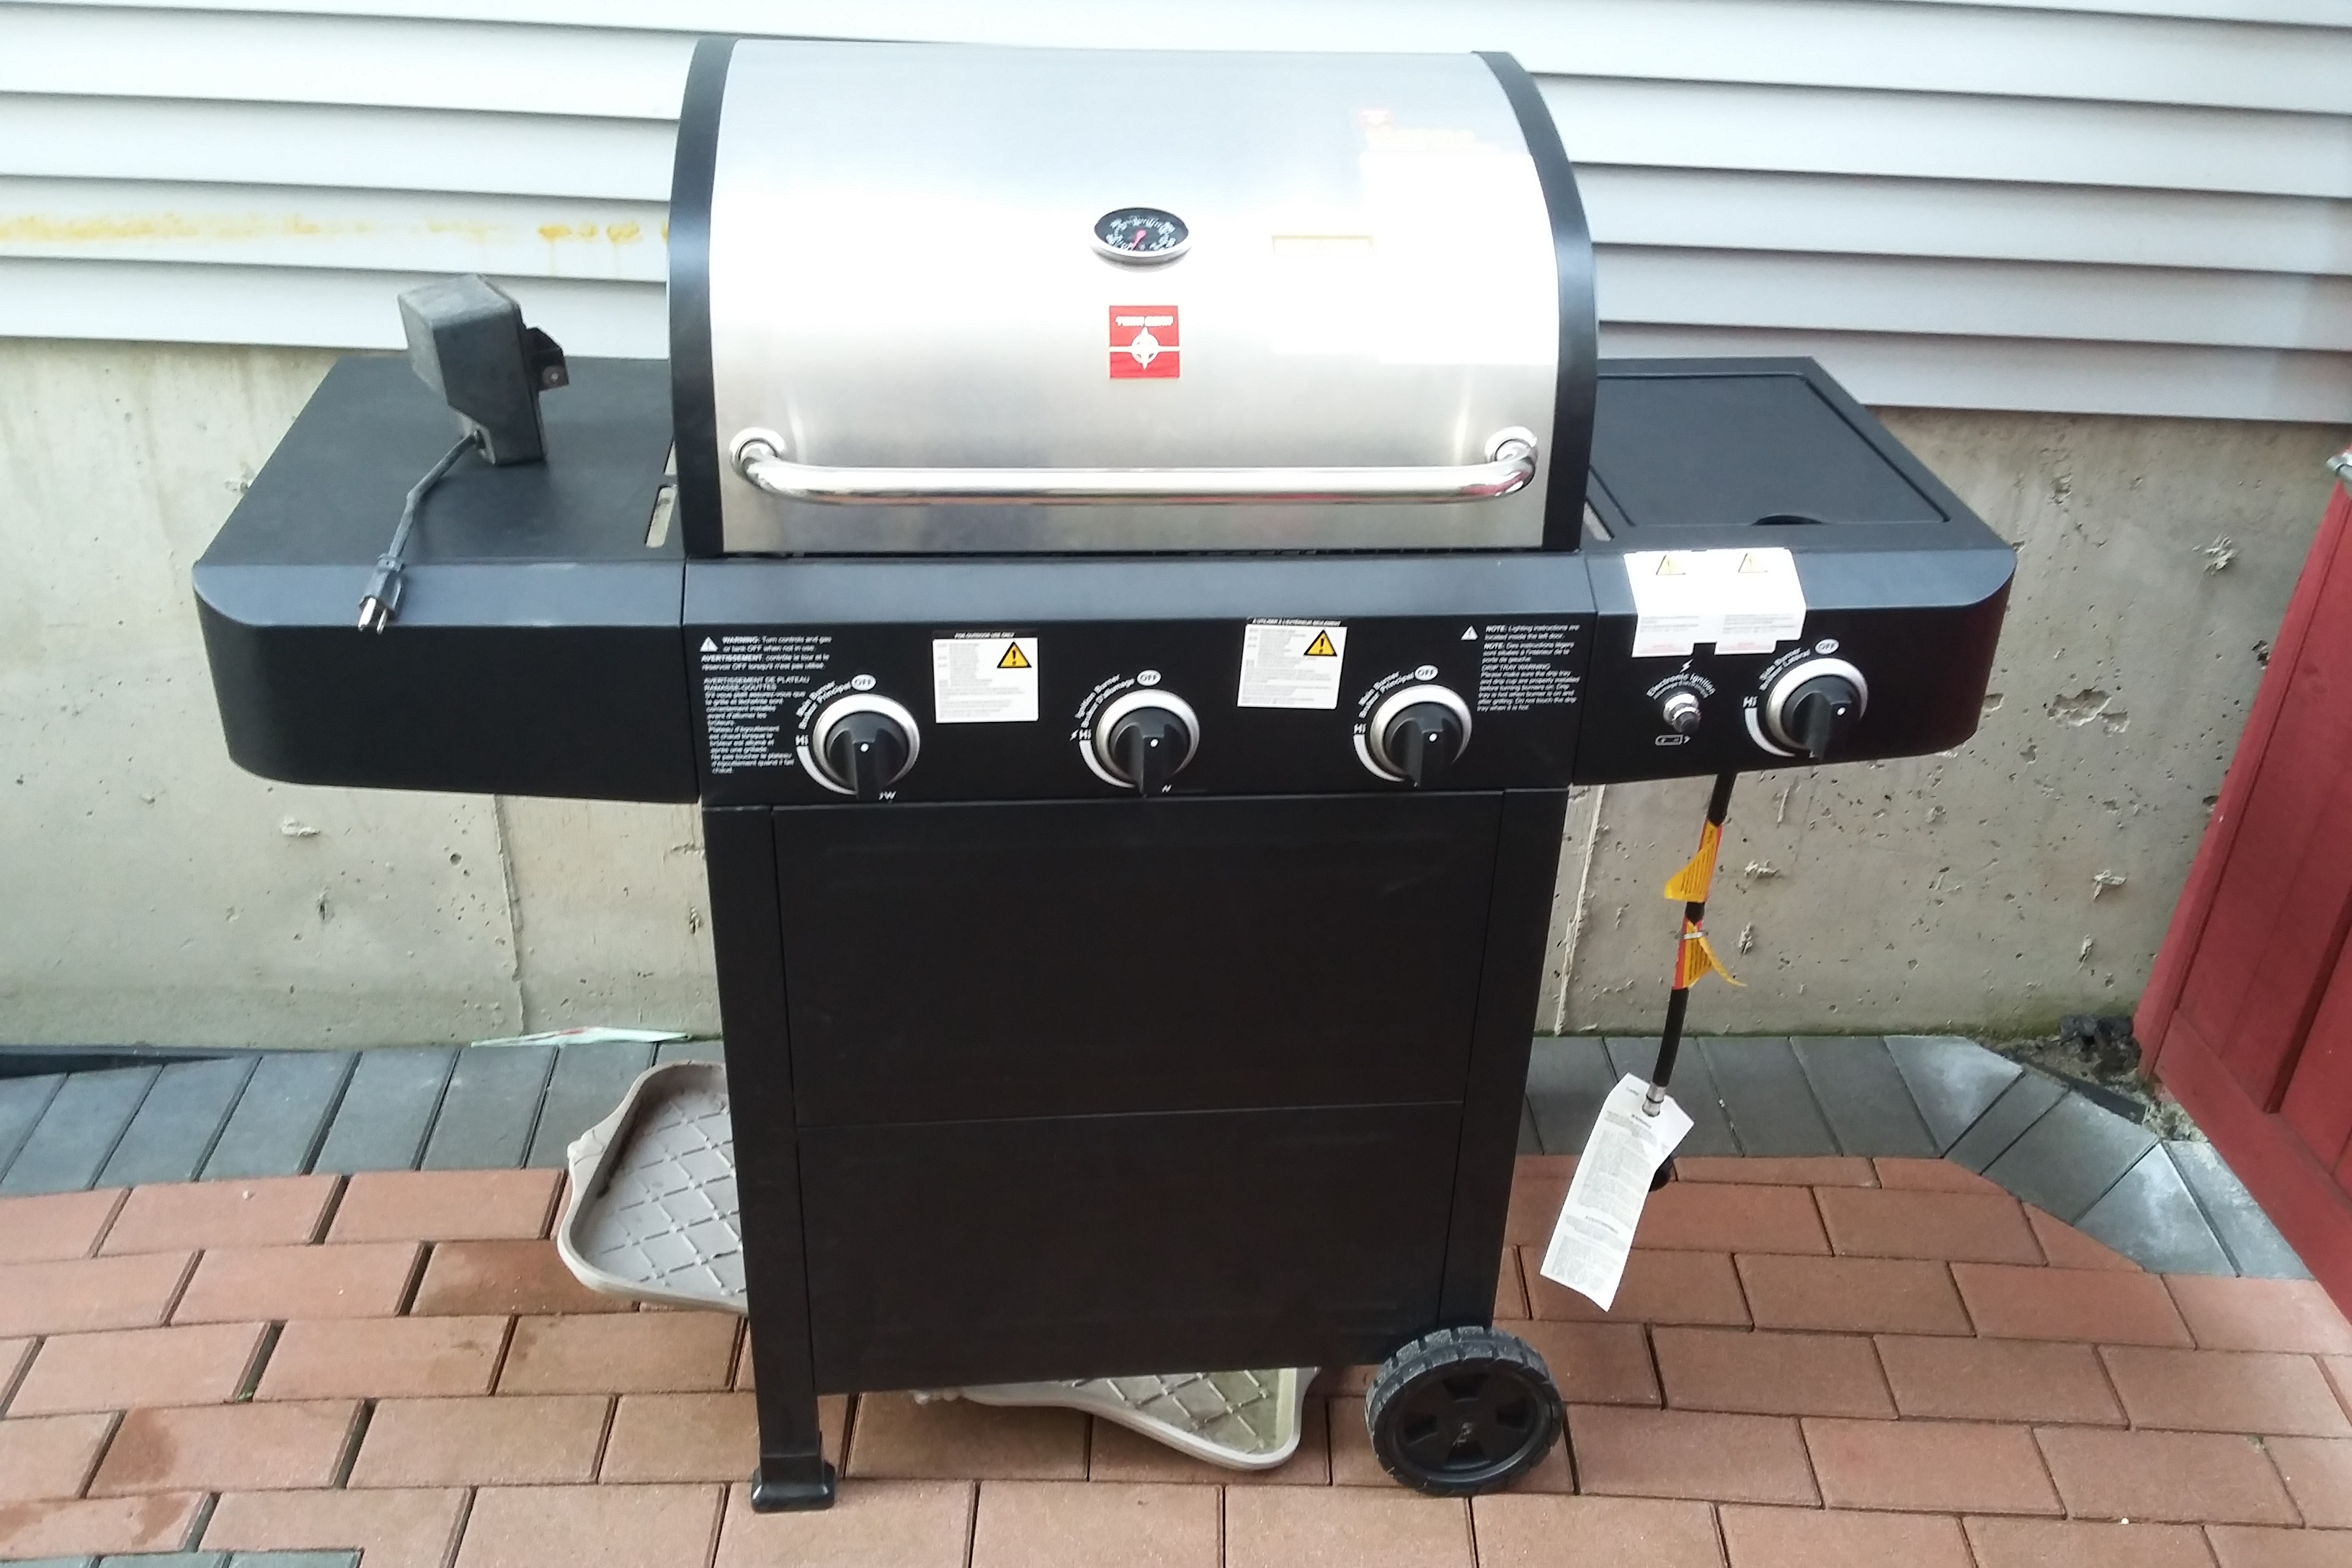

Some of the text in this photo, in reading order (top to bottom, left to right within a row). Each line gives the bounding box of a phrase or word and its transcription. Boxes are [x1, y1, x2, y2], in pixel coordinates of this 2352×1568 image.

[1743, 696, 1758, 707] Hi
[1354, 723, 1366, 734] Hi
[1079, 729, 1091, 739] Hi
[796, 735, 808, 745] Hi
